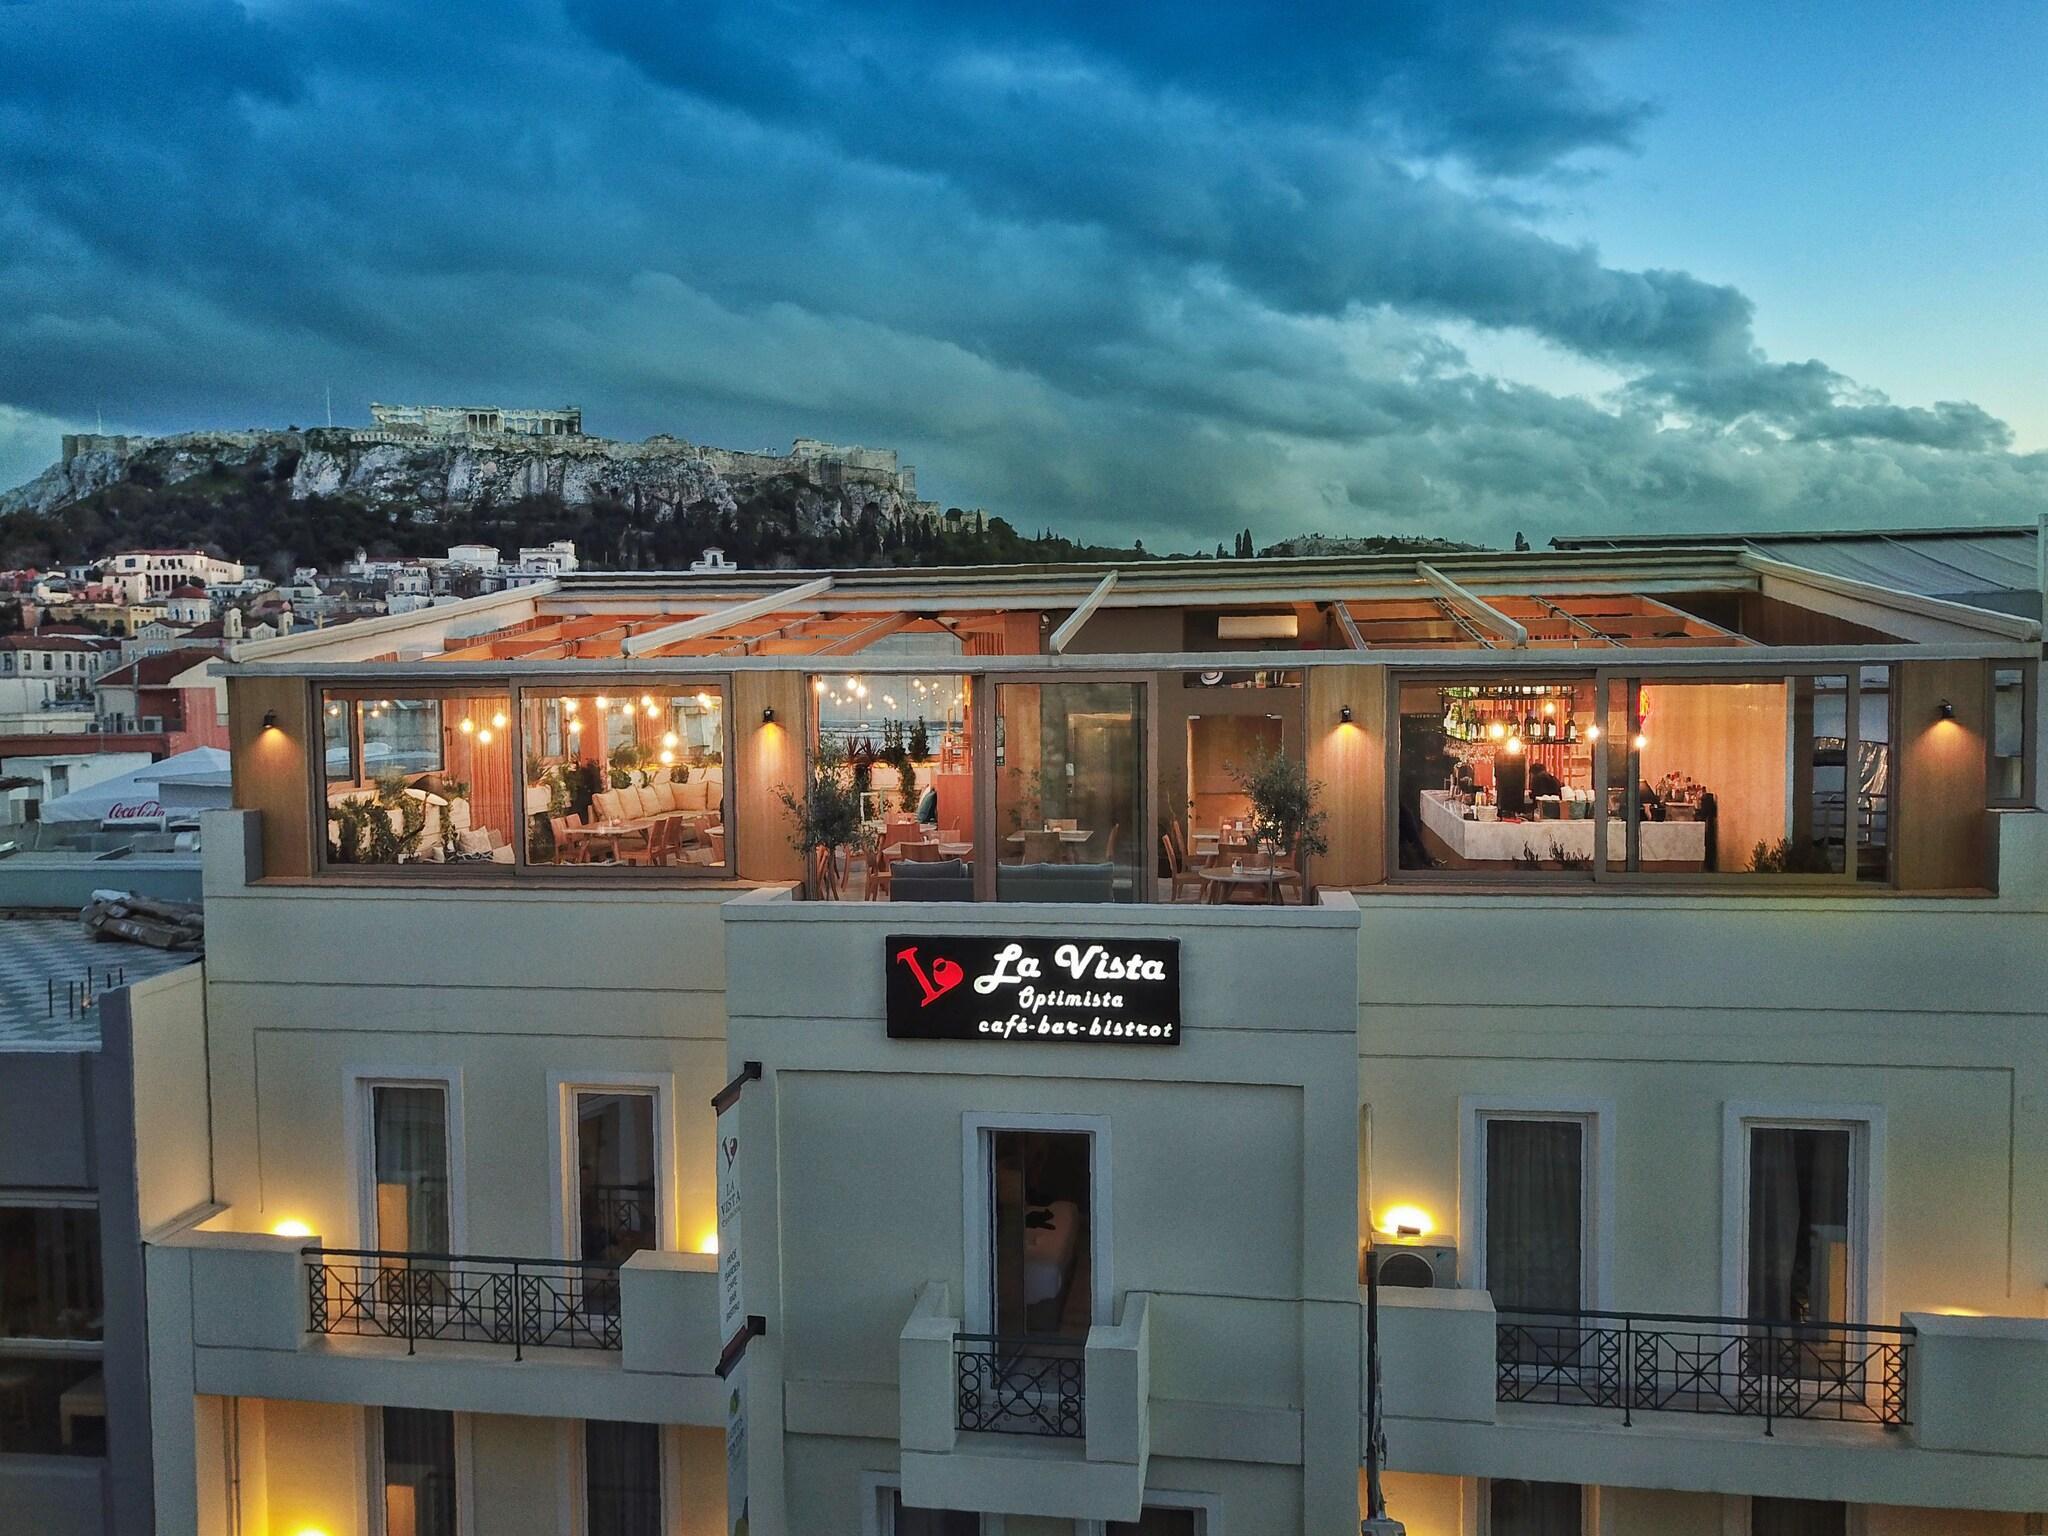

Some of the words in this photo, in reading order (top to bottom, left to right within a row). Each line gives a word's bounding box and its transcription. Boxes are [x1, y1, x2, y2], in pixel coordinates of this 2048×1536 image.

[973, 943, 1042, 995] La
[1054, 944, 1167, 981] Vista
[1018, 986, 1125, 1015] Optimista
[720, 1189, 741, 1216] VISTA
